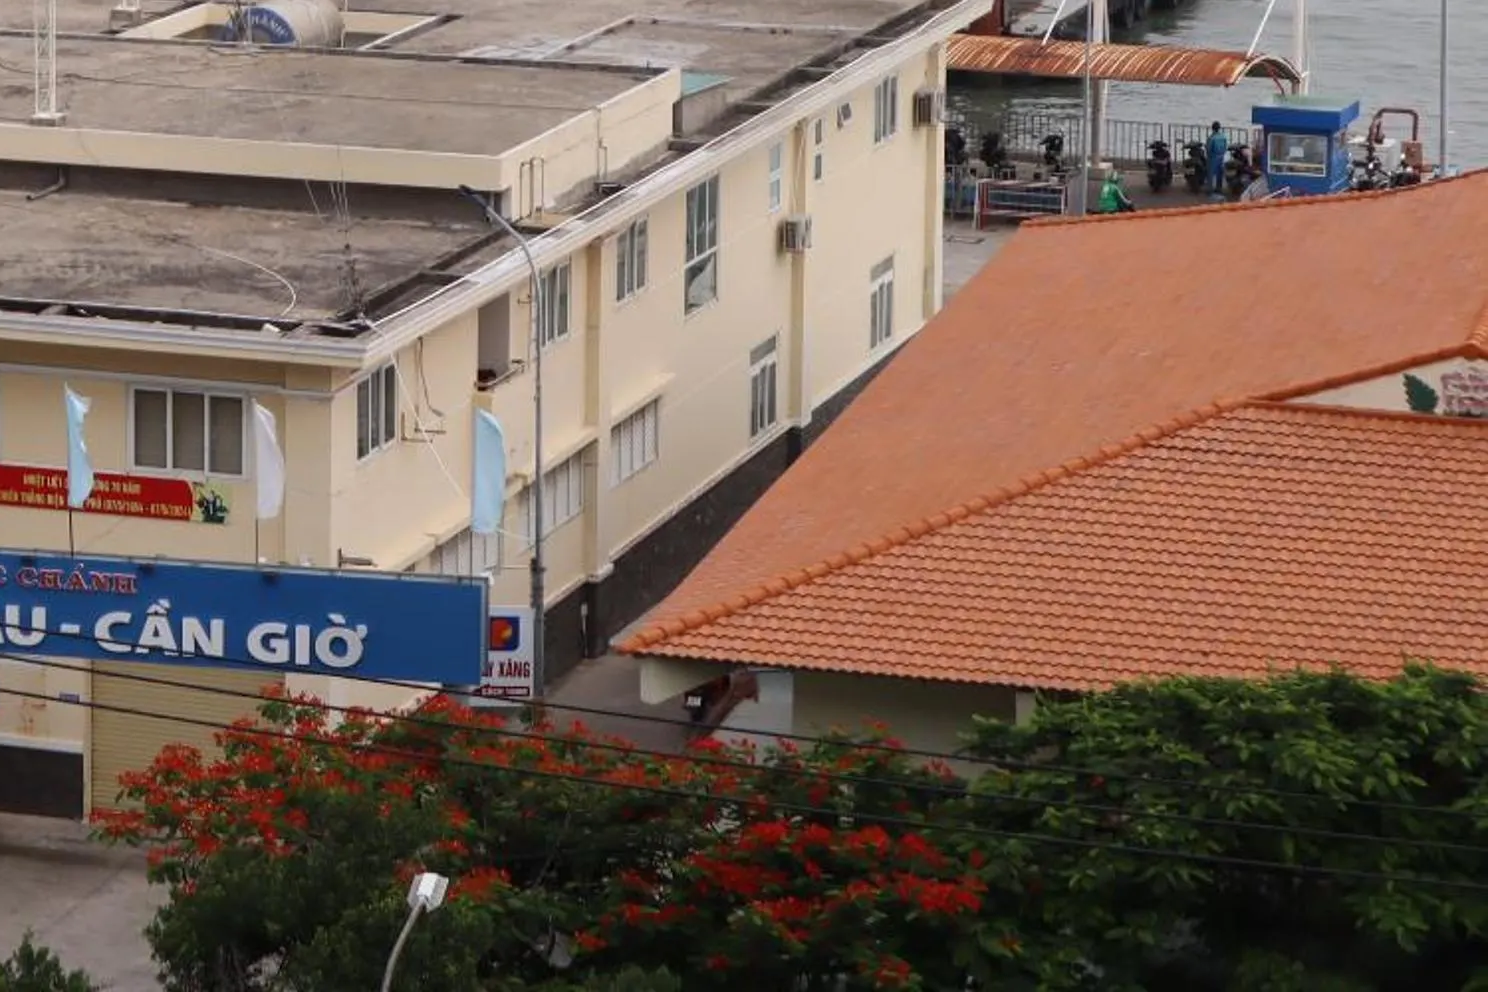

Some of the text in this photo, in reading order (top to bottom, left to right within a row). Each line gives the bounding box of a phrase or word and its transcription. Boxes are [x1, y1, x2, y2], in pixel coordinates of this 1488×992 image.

[15, 562, 138, 595] CHÁNH
[94, 598, 225, 657] CẦN
[246, 612, 368, 668] GIỜ
[498, 658, 531, 679] XĂNG
